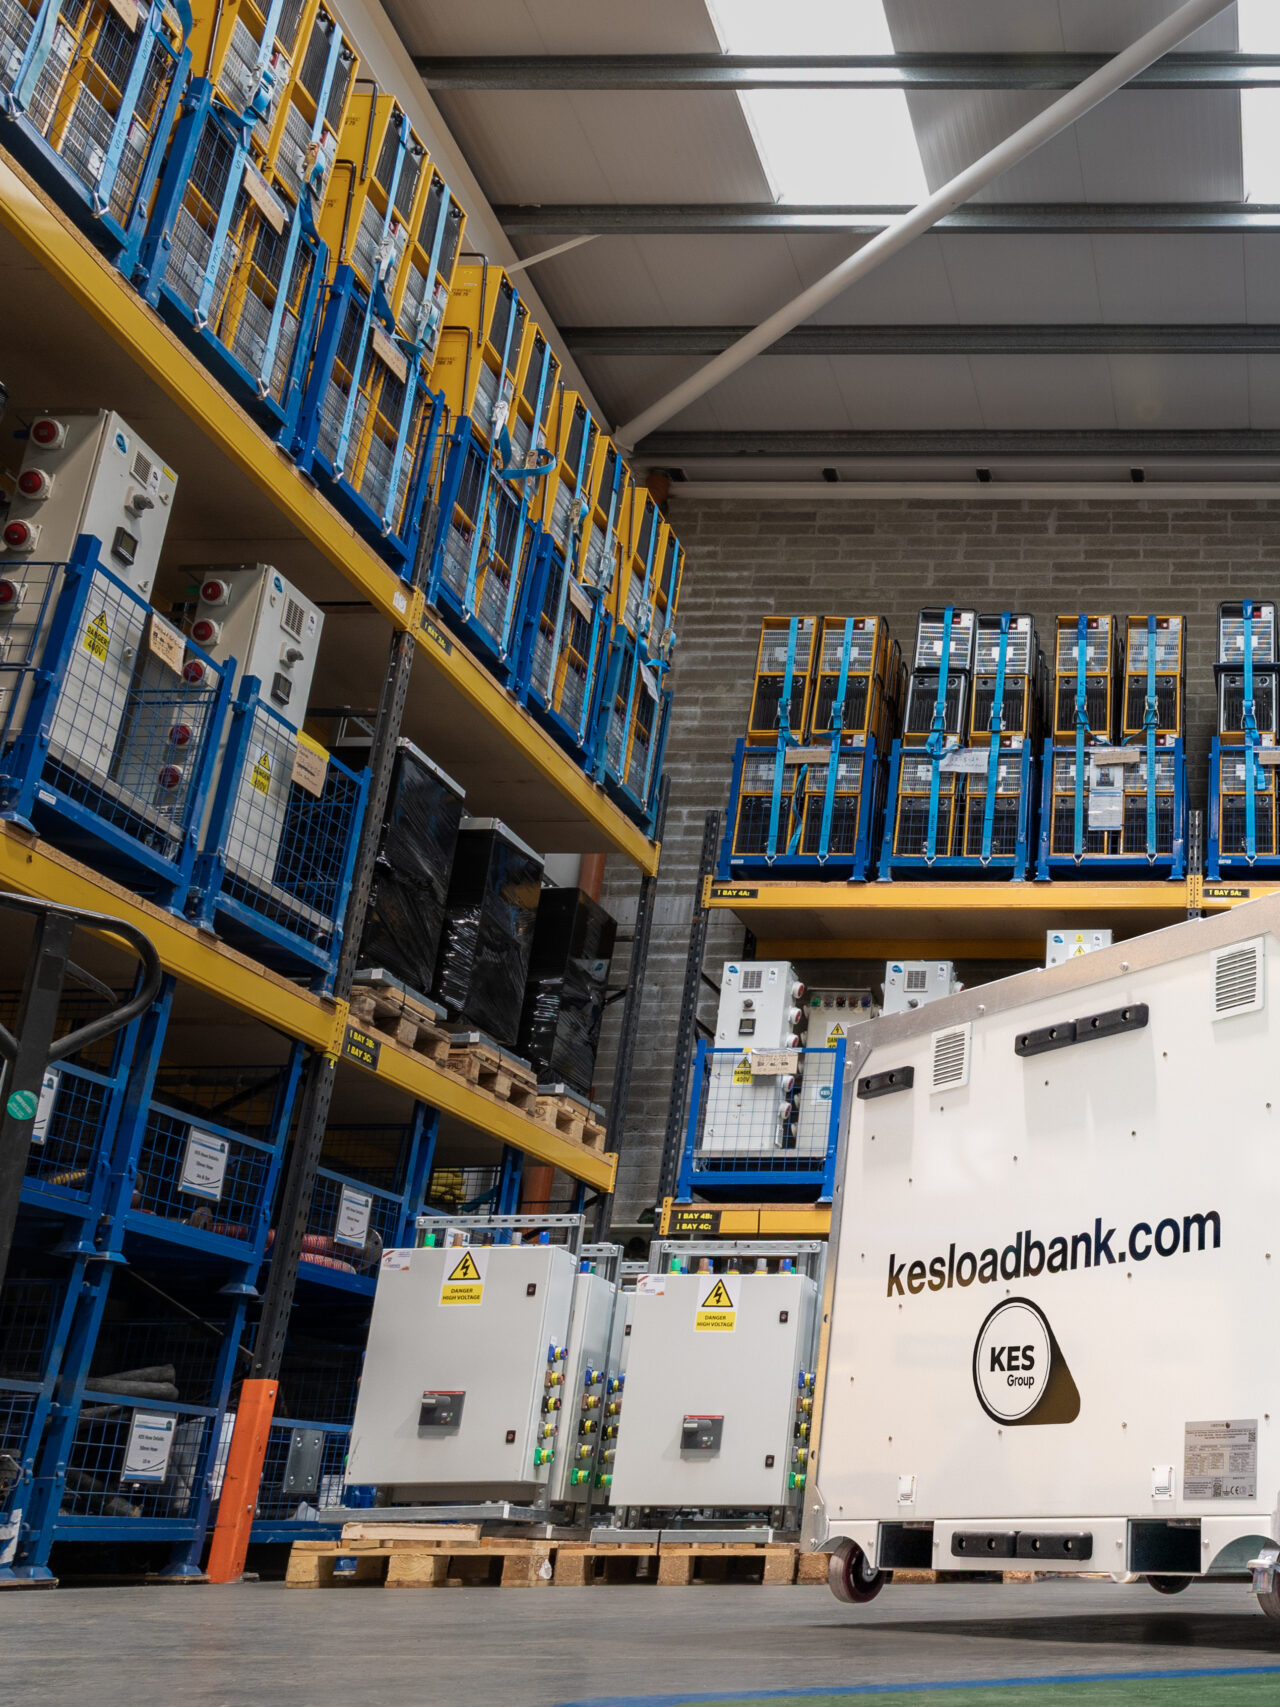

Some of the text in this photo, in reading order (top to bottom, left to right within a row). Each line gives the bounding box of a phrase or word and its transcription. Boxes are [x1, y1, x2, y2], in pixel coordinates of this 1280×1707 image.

[115, 119, 127, 150] KES
[210, 244, 221, 275] KES
[353, 1032, 366, 1044] BAY
[350, 1046, 363, 1058] BAY
[700, 1212, 713, 1220] 4B:
[886, 1210, 1221, 1298] kesloadbank.com
[989, 1345, 1035, 1372] KES
[1007, 1374, 1035, 1390] Group
